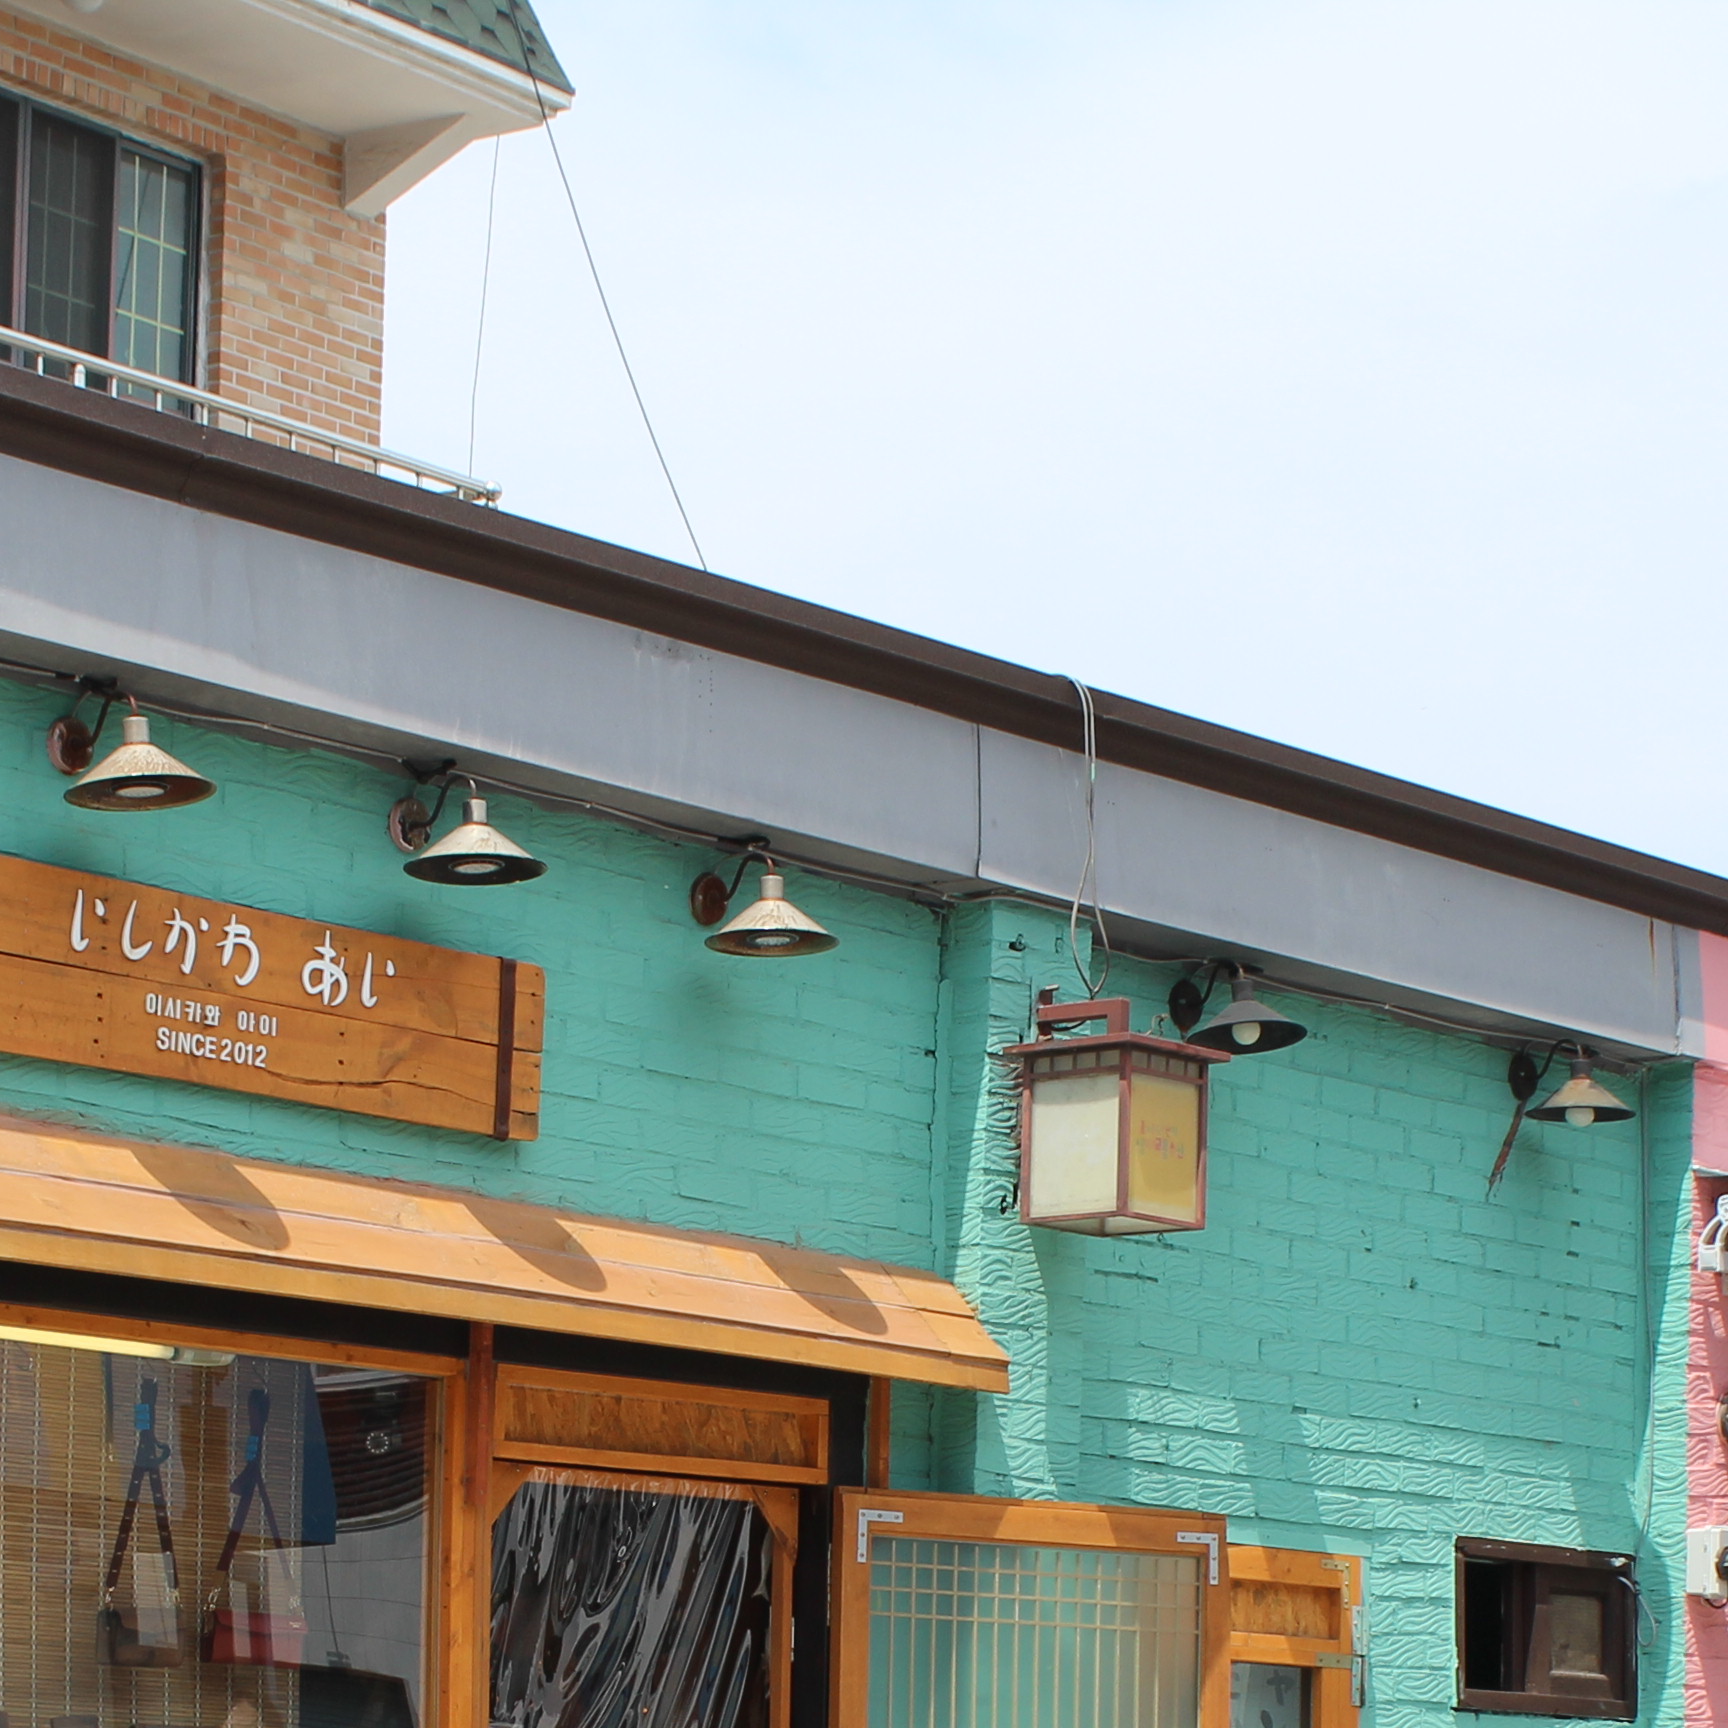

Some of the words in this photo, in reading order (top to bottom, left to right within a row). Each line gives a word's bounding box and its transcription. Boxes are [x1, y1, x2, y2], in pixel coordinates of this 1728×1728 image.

[144, 991, 223, 1028] 이시카와
[235, 1008, 279, 1038] 아이
[154, 1025, 217, 1062] SINCE
[218, 1036, 268, 1070] 2012
